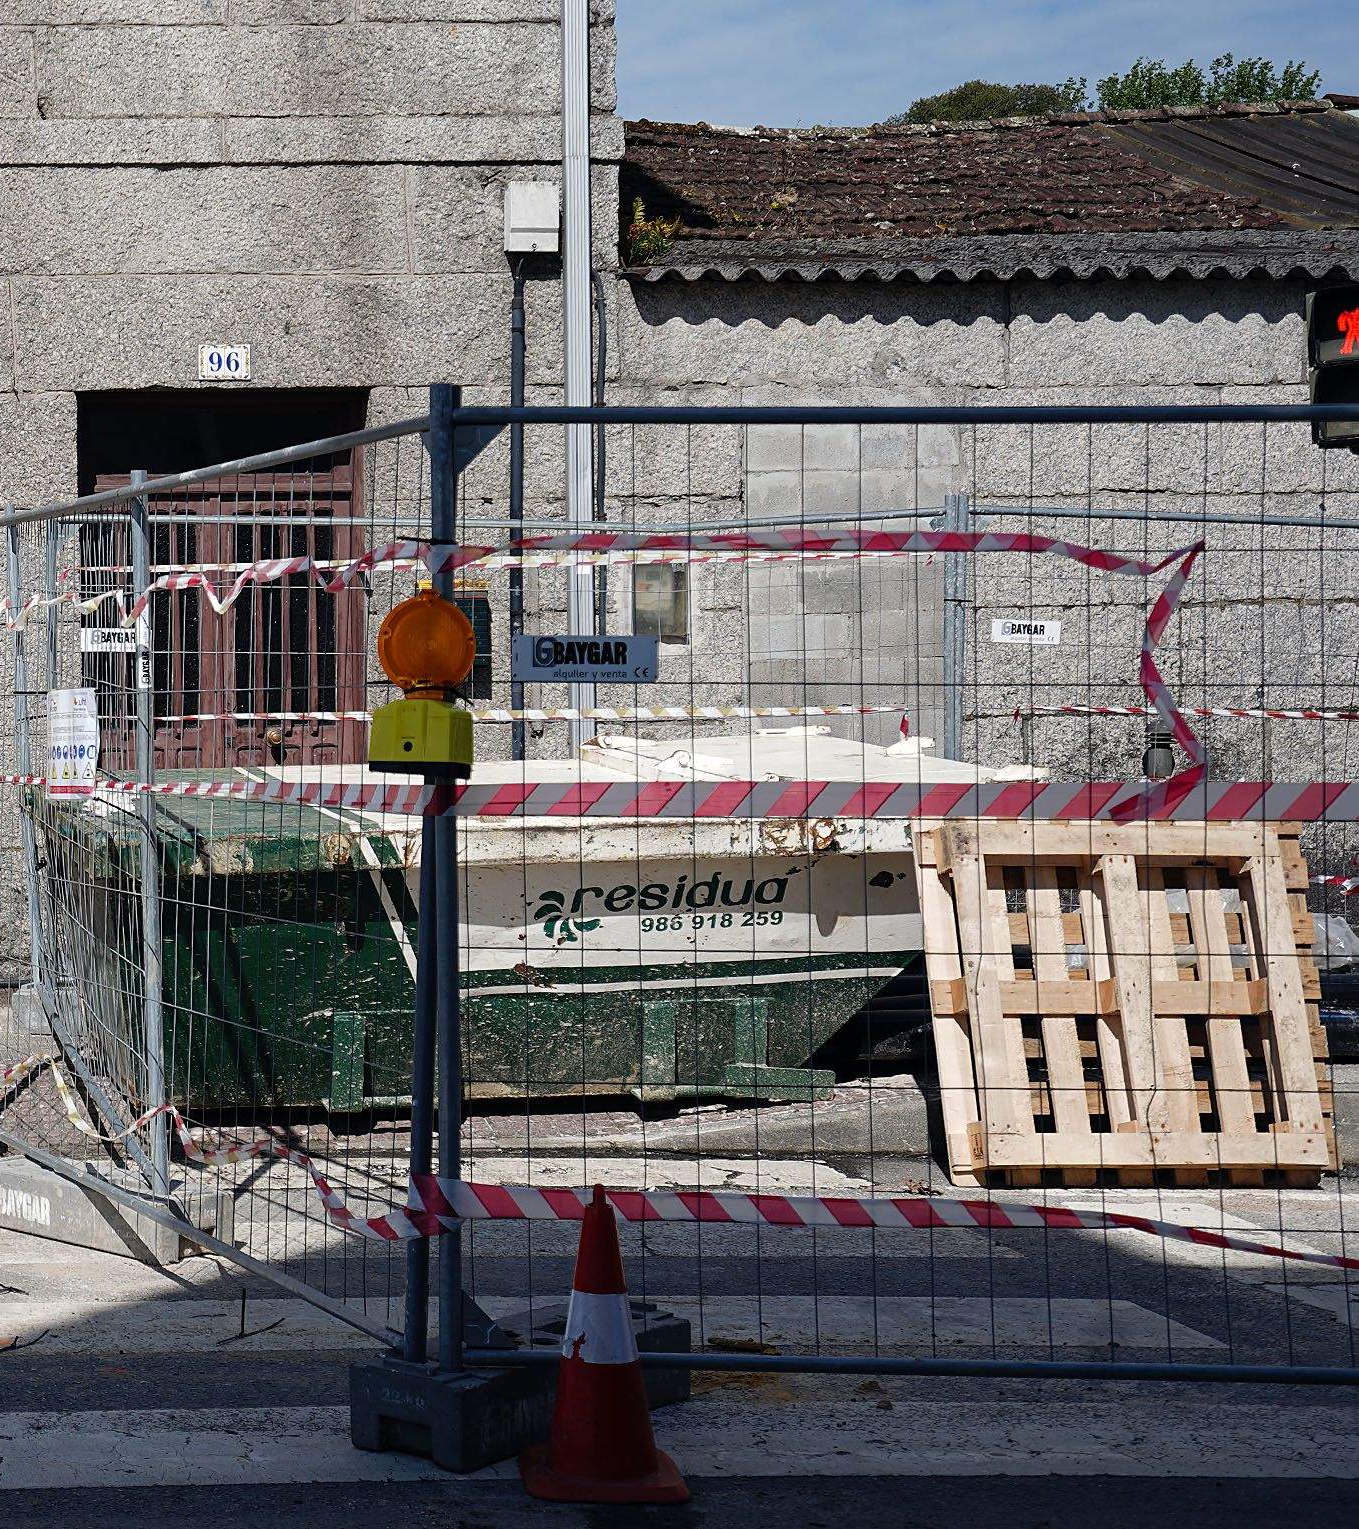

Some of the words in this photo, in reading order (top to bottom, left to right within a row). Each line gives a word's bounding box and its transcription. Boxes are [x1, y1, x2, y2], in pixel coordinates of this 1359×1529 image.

[208, 351, 240, 372] 96
[101, 631, 136, 643] BAYGAR
[1011, 623, 1045, 635] BAYGAR
[553, 641, 628, 665] BAYGAR
[592, 670, 600, 680] y
[601, 669, 628, 679] venta
[570, 871, 790, 913] residua
[641, 913, 683, 932] 986
[692, 911, 734, 930] 918
[740, 910, 784, 928] 259
